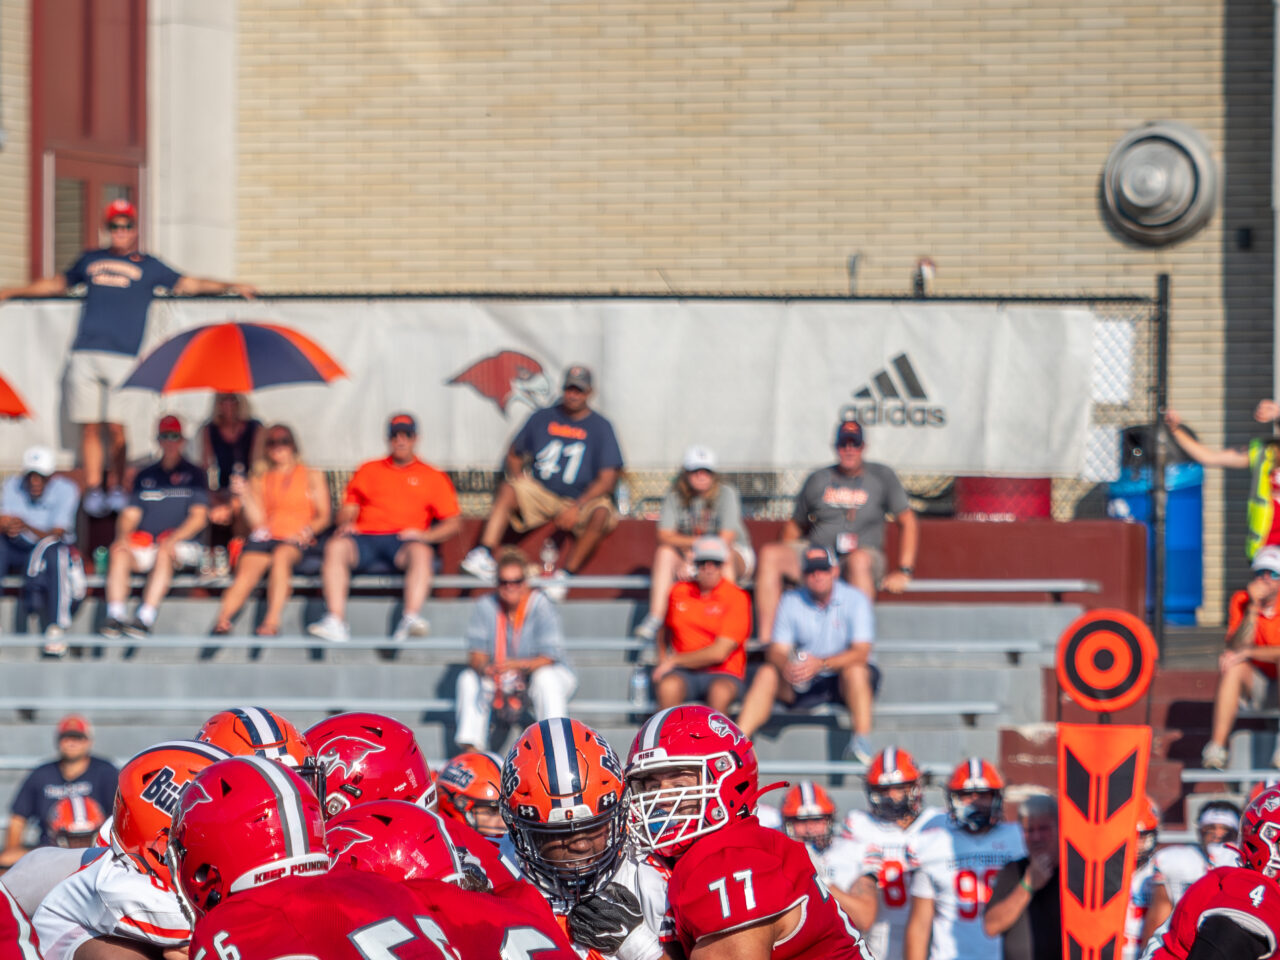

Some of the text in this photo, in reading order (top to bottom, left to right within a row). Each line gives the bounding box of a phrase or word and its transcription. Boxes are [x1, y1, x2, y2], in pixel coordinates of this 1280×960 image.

[840, 399, 947, 427] adidas
[534, 439, 586, 484] 41
[638, 751, 654, 760] RISE
[254, 866, 286, 884] KEEP
[708, 869, 756, 919] 77
[1249, 885, 1266, 908] 4
